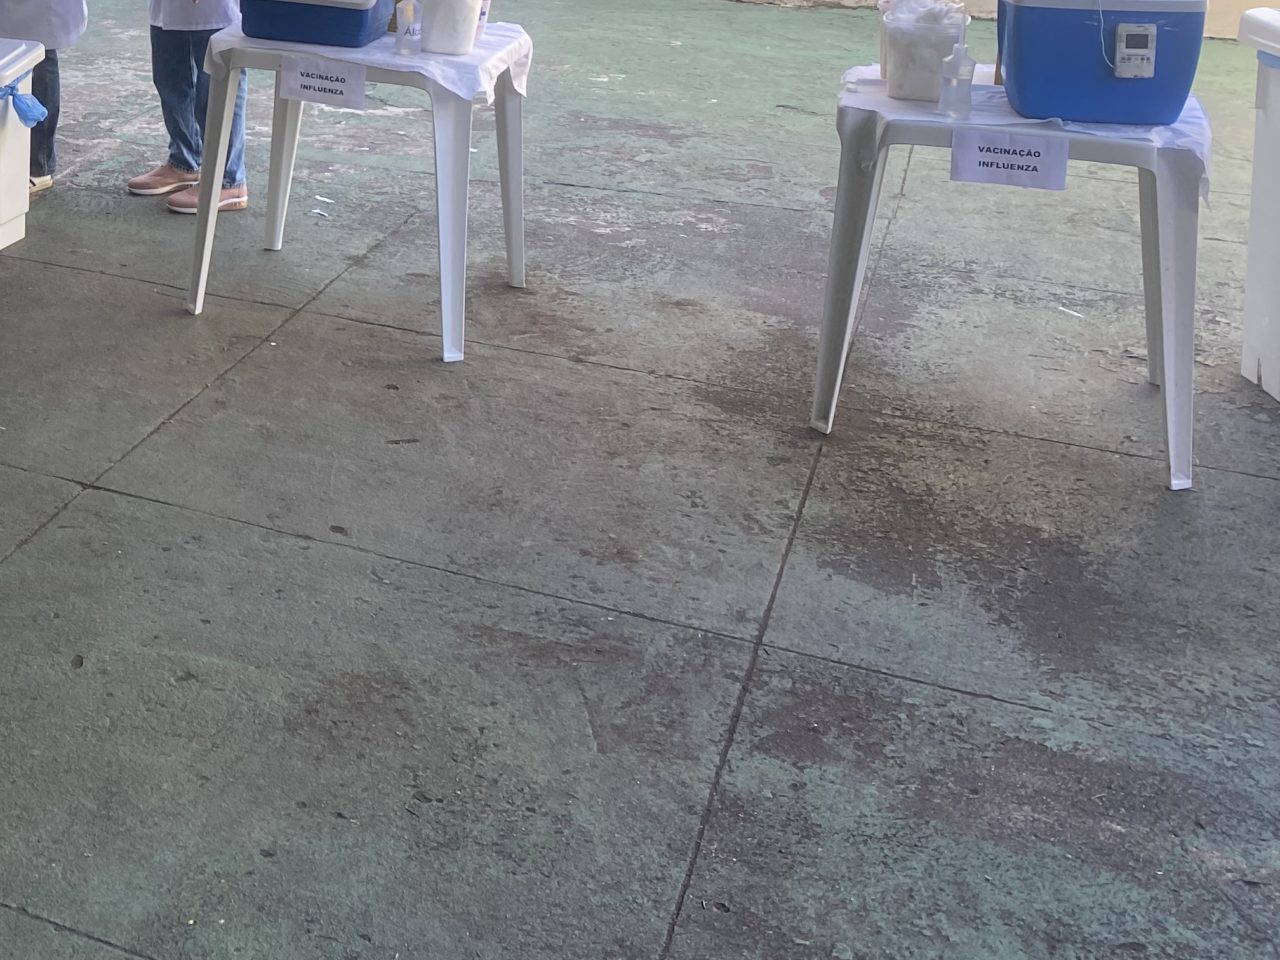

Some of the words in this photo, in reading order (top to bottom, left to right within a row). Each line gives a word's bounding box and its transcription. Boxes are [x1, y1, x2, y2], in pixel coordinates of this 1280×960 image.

[300, 71, 346, 84] VACINAÇÃO
[300, 83, 345, 96] INFLUENZA
[977, 145, 1041, 158] VACINAÇÃO
[978, 160, 1039, 173] INFLUENZA
